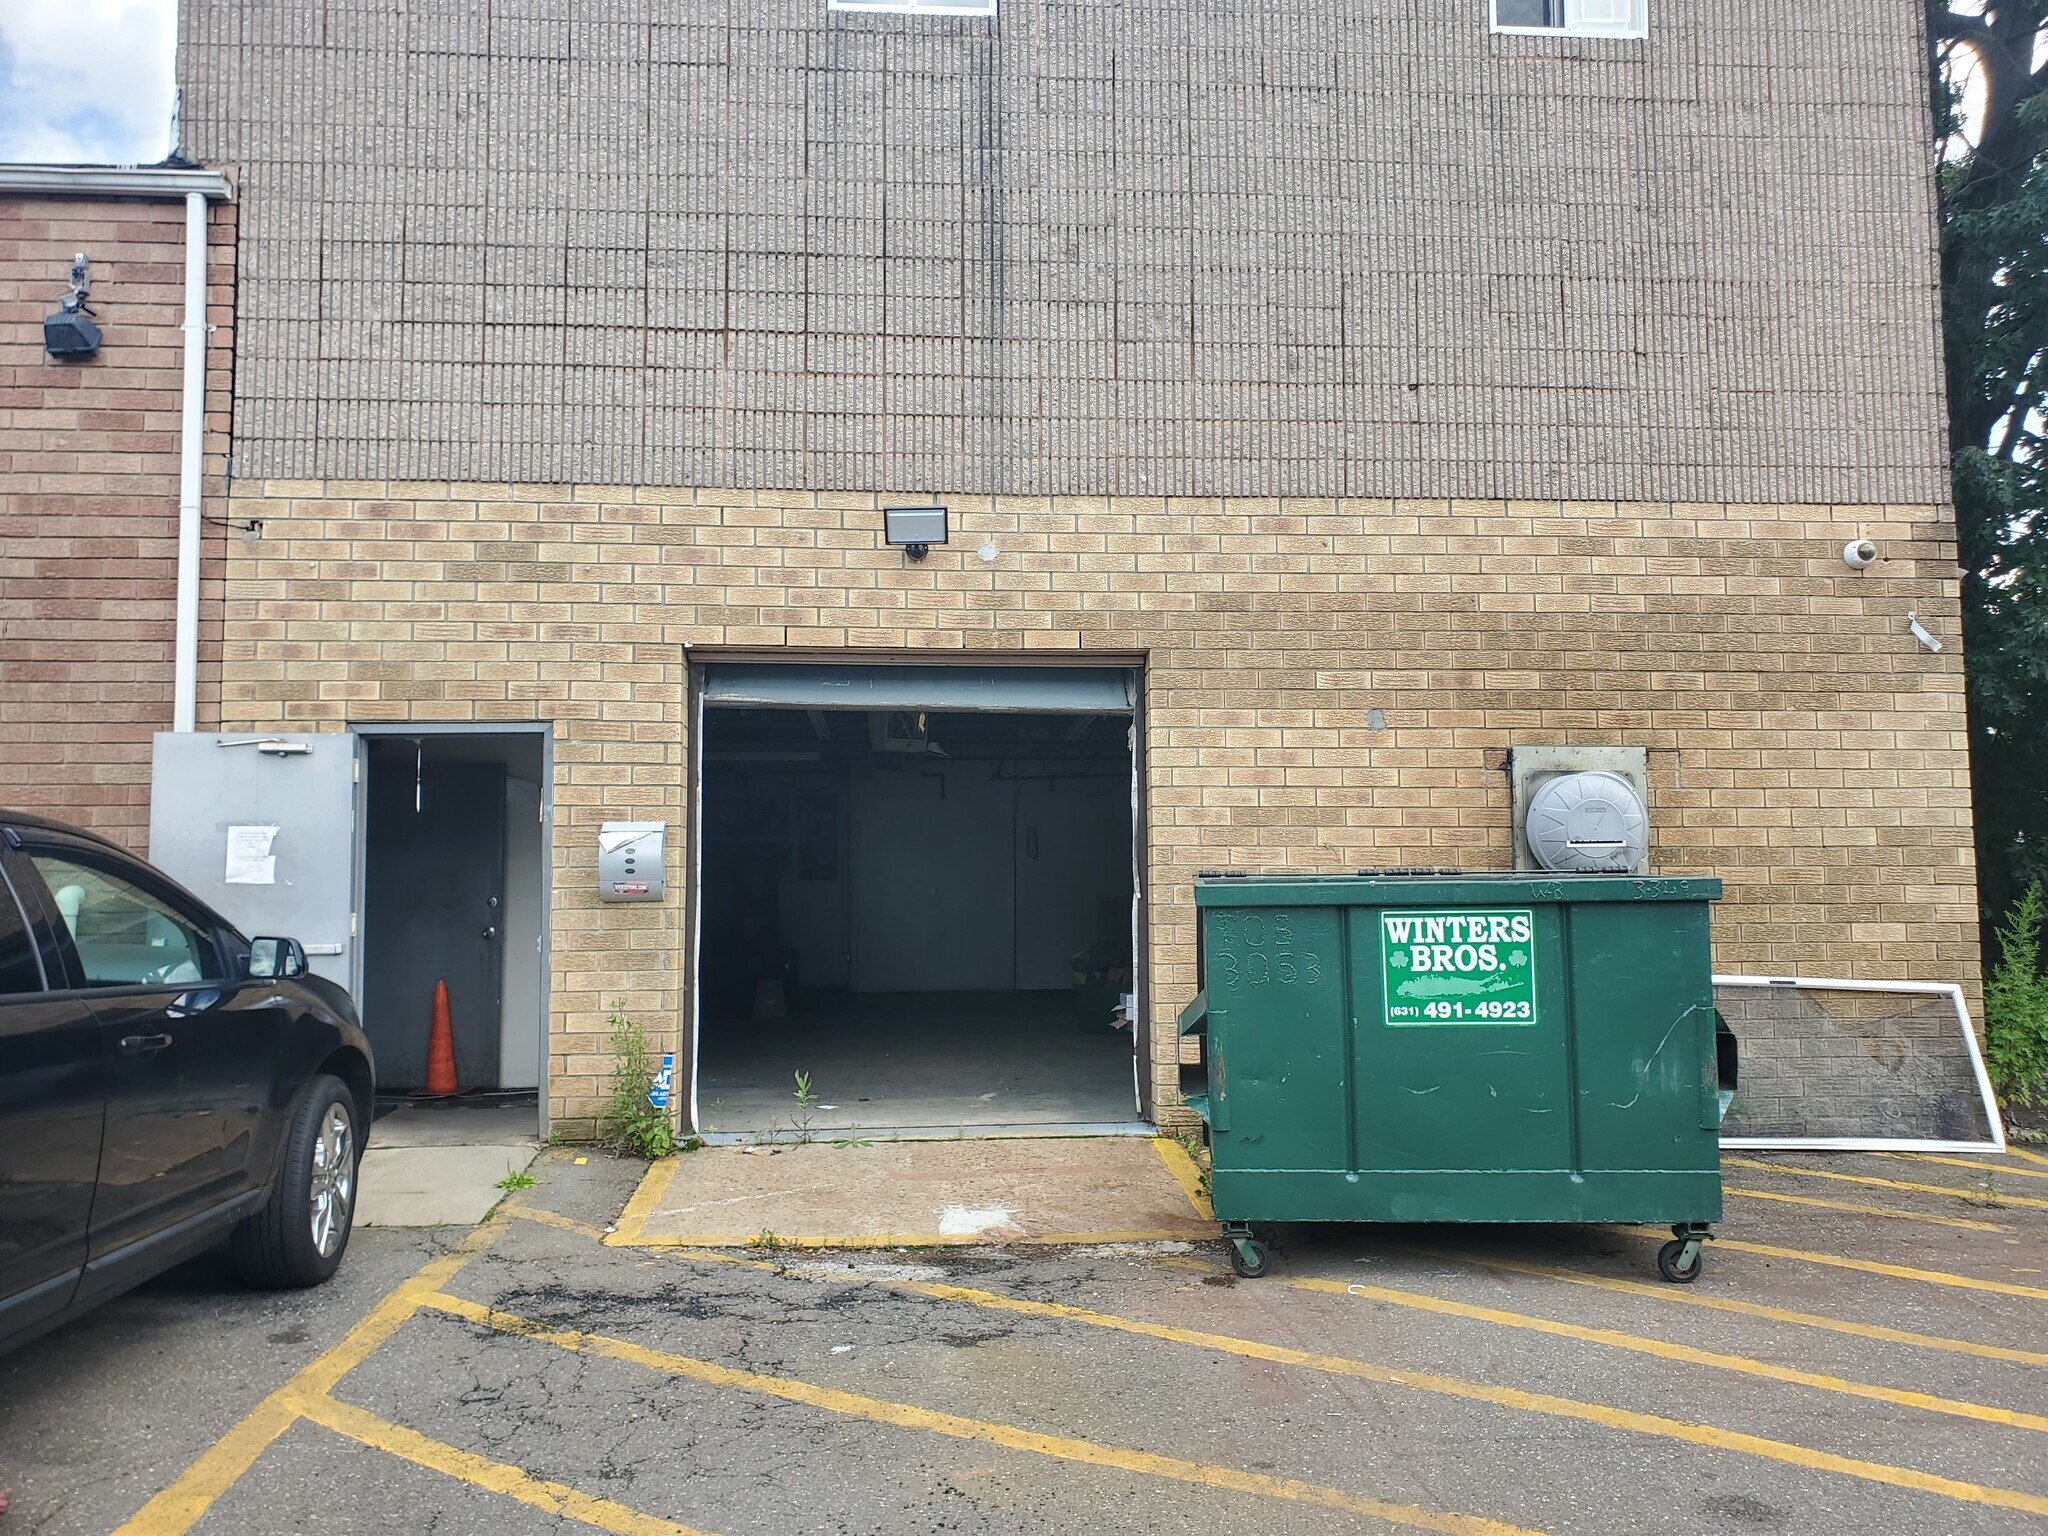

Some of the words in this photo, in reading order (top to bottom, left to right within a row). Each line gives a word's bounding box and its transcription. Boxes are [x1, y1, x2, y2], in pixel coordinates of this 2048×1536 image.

[1384, 915, 1531, 944] WINTERS
[1409, 944, 1507, 972] BROS.
[1389, 1006, 1420, 1018] (631)
[1423, 1001, 1531, 1019] 491-4923
